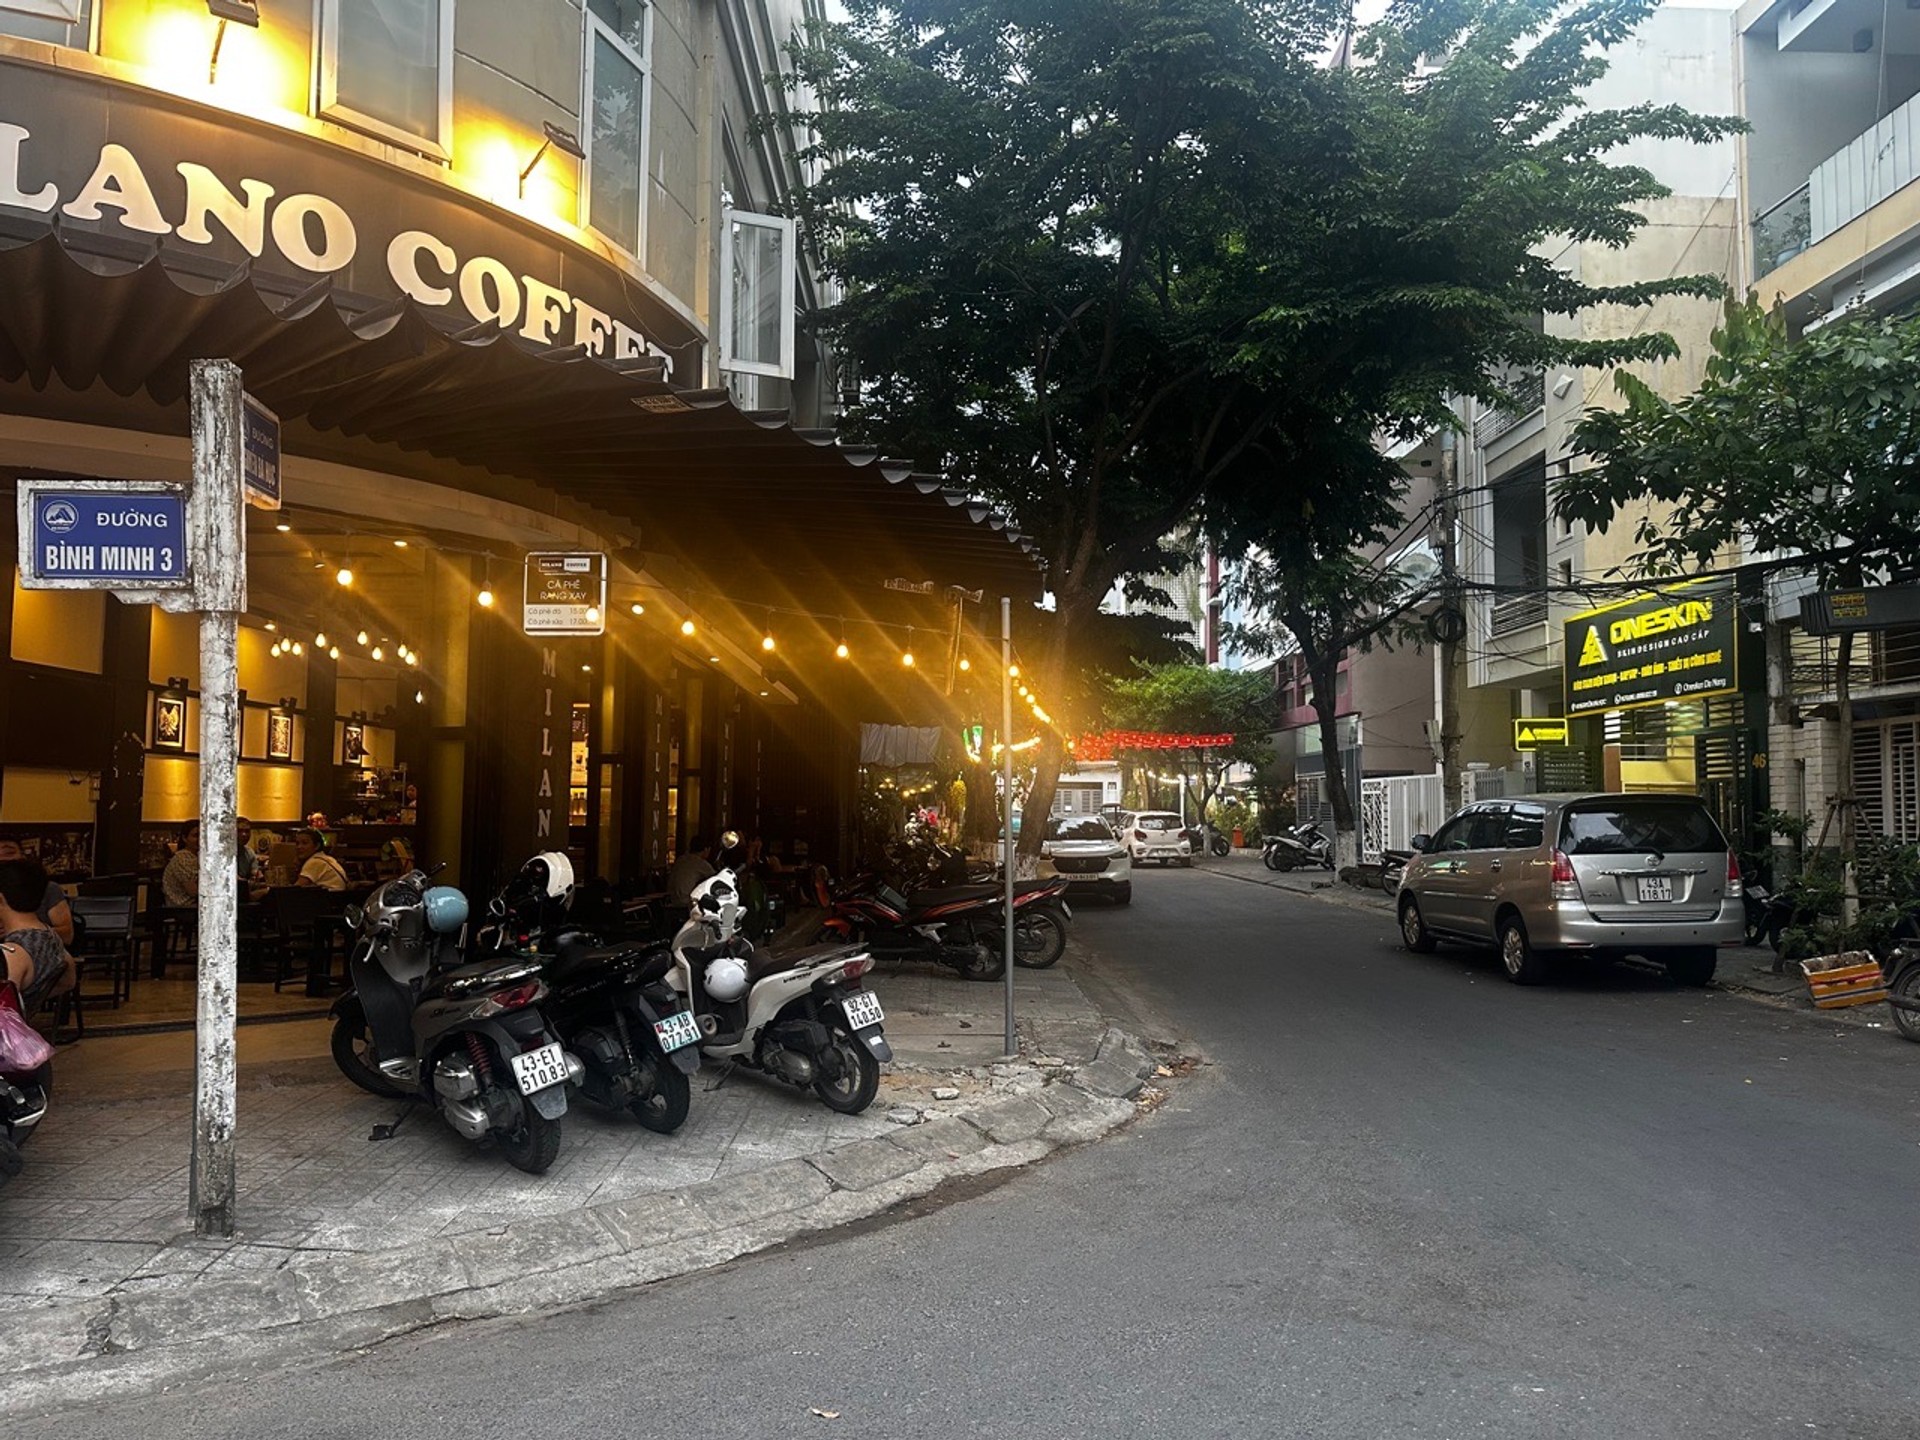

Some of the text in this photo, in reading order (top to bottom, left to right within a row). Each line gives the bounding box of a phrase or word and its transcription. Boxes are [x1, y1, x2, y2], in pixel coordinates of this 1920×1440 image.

[97, 509, 168, 528] ĐƯỜNG
[46, 540, 173, 571] BÌNH MINH 3
[1610, 599, 1713, 645] ONESKIN
[536, 646, 557, 854] MILAN
[1752, 753, 1766, 769] 46
[1646, 877, 1665, 889] 43A
[661, 1025, 699, 1051] 072.91
[521, 1048, 556, 1072] 43-E1
[521, 1062, 567, 1092] 510.83
